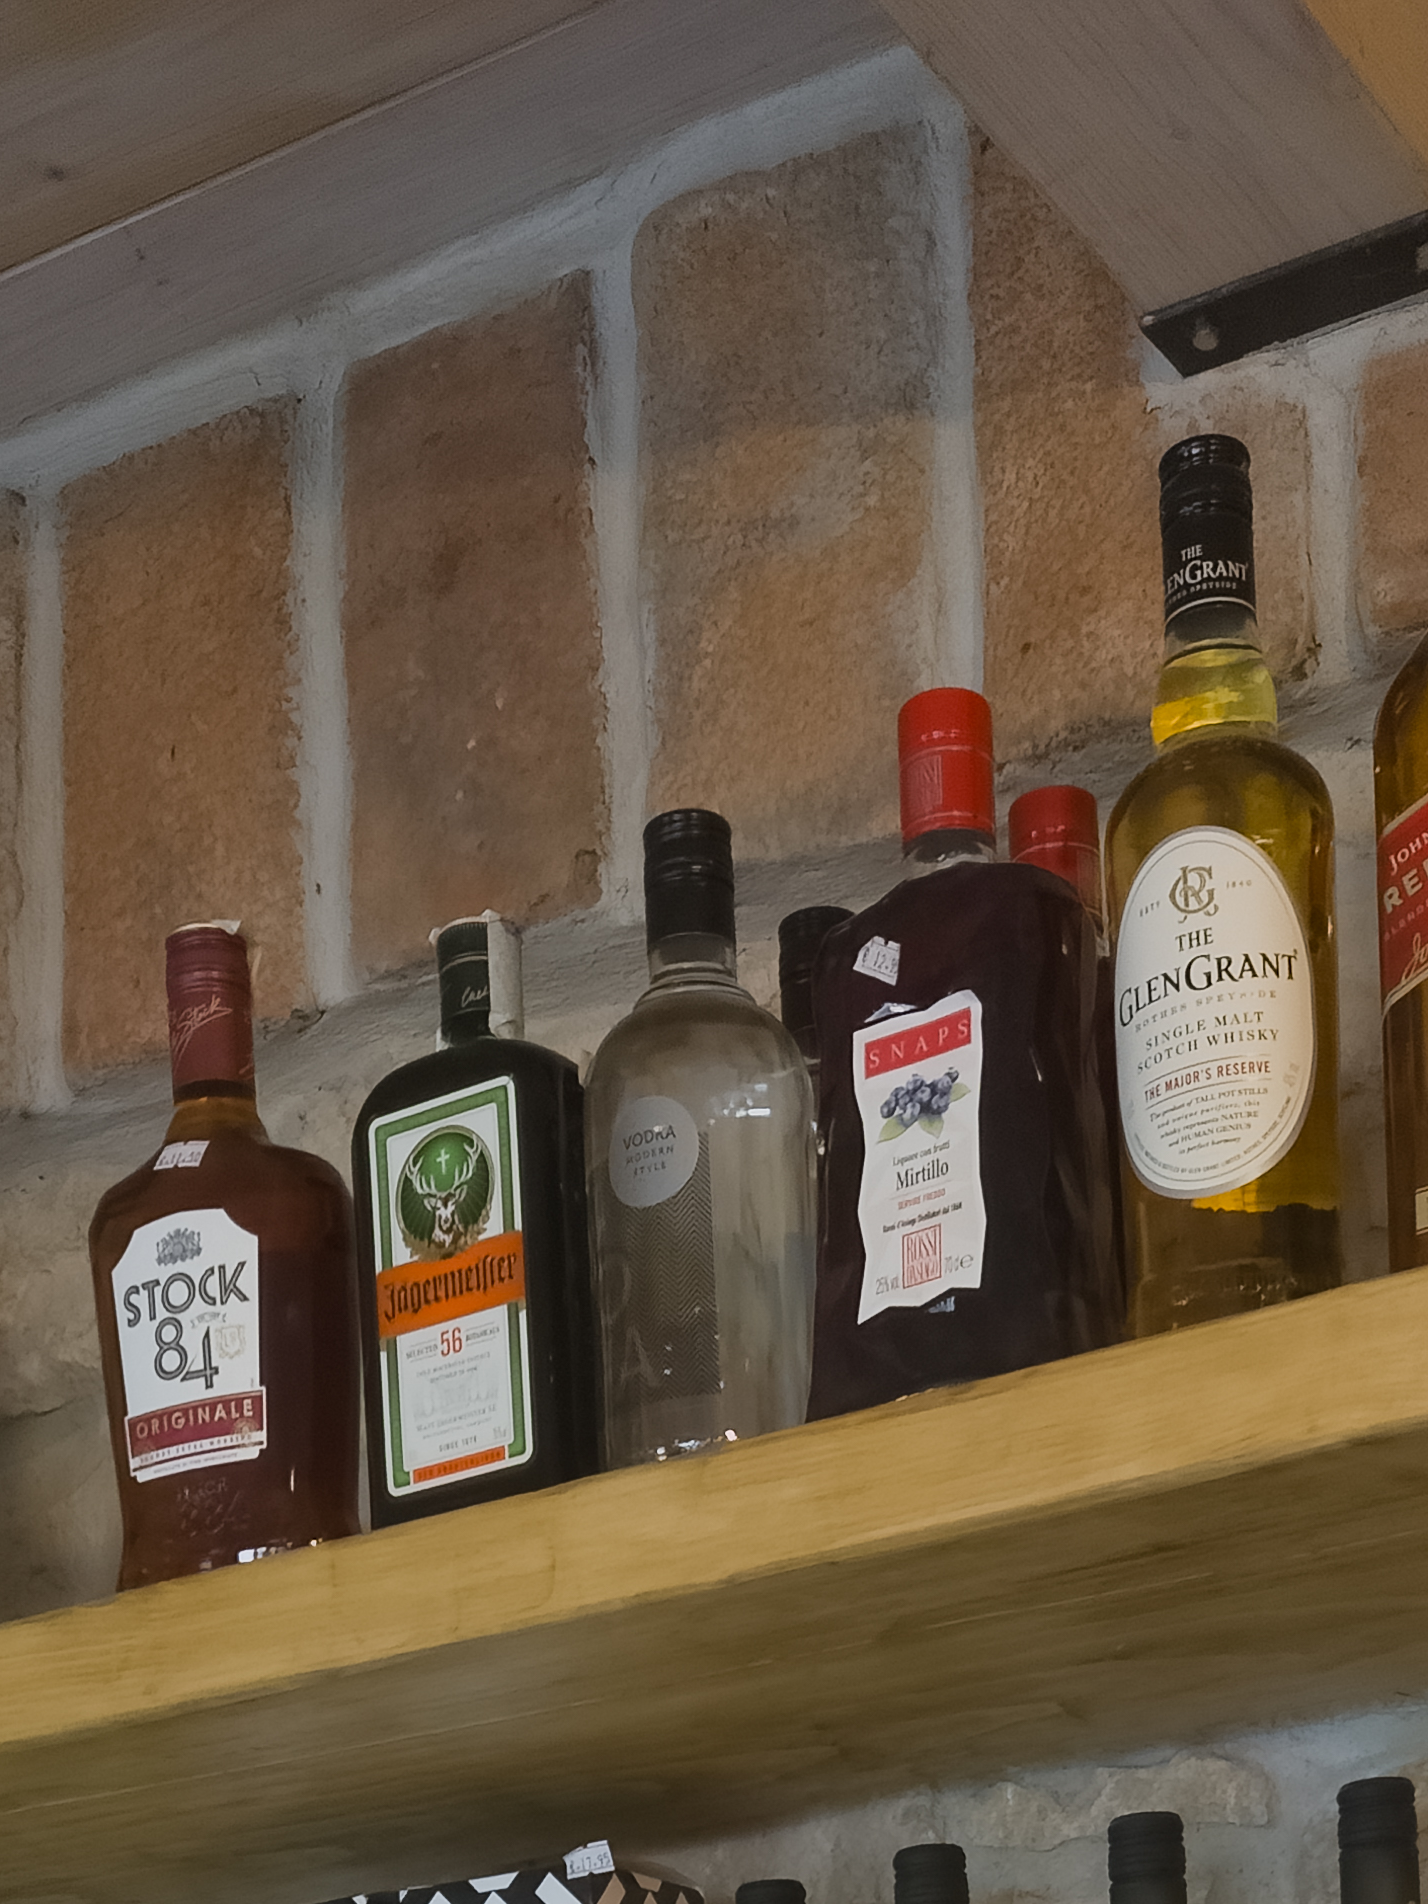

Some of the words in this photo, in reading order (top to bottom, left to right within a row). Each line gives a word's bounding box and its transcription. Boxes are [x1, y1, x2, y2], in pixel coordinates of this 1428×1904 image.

[1180, 544, 1203, 562] THE
[1174, 927, 1214, 952] THE
[1118, 948, 1300, 1028] GLENGRANT
[869, 1018, 969, 1069] SNAPS
[1145, 1017, 1207, 1051] SINGLE
[1213, 1010, 1264, 1029] MALT
[1136, 1038, 1199, 1074] SCOTCH
[1215, 1059, 1272, 1079] RESERVE
[622, 1124, 677, 1151] VODKA
[895, 1157, 949, 1192] Mirtillo
[123, 1261, 251, 1329] STOCK
[154, 1316, 221, 1391] 84
[440, 1326, 465, 1358] 56
[135, 1397, 256, 1441] ORIGINALE
